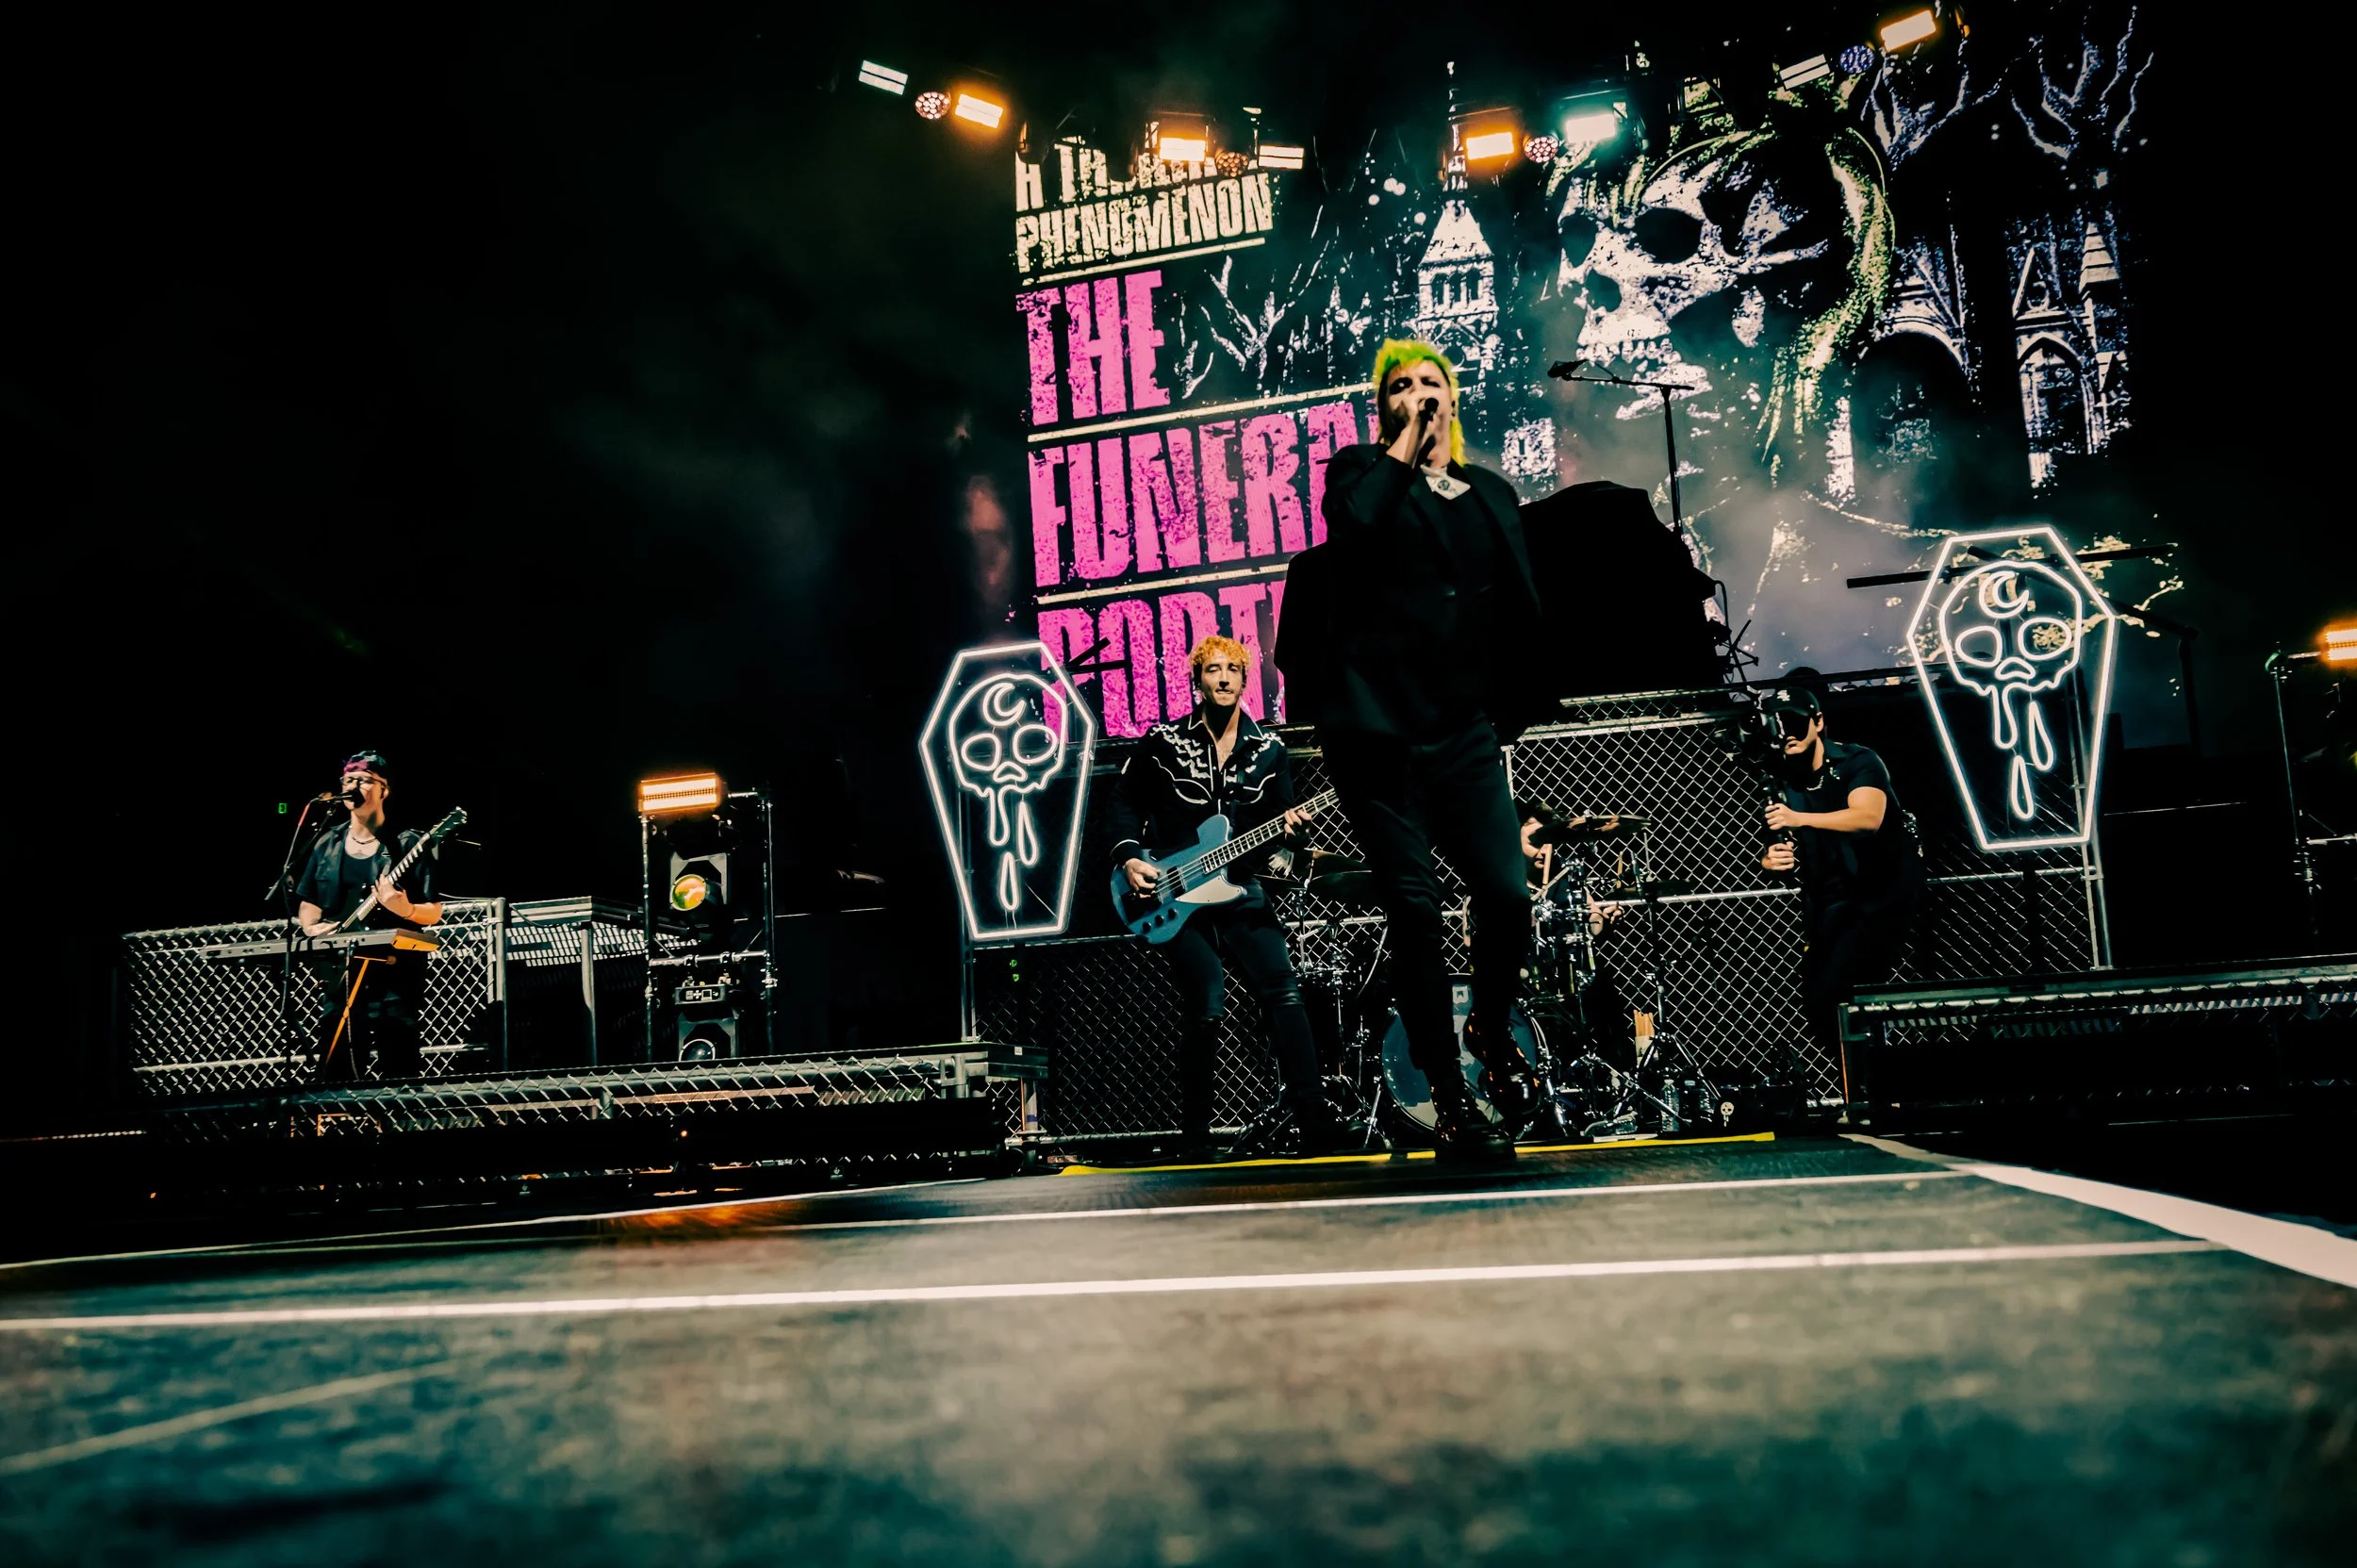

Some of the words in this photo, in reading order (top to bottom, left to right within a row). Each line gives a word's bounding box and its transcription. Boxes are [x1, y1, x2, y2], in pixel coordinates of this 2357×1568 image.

[1015, 173, 1274, 272] PHENOMENON
[1015, 270, 1171, 426] THE
[1028, 399, 1379, 587] FUNERA
[1037, 579, 1288, 743] PORT
